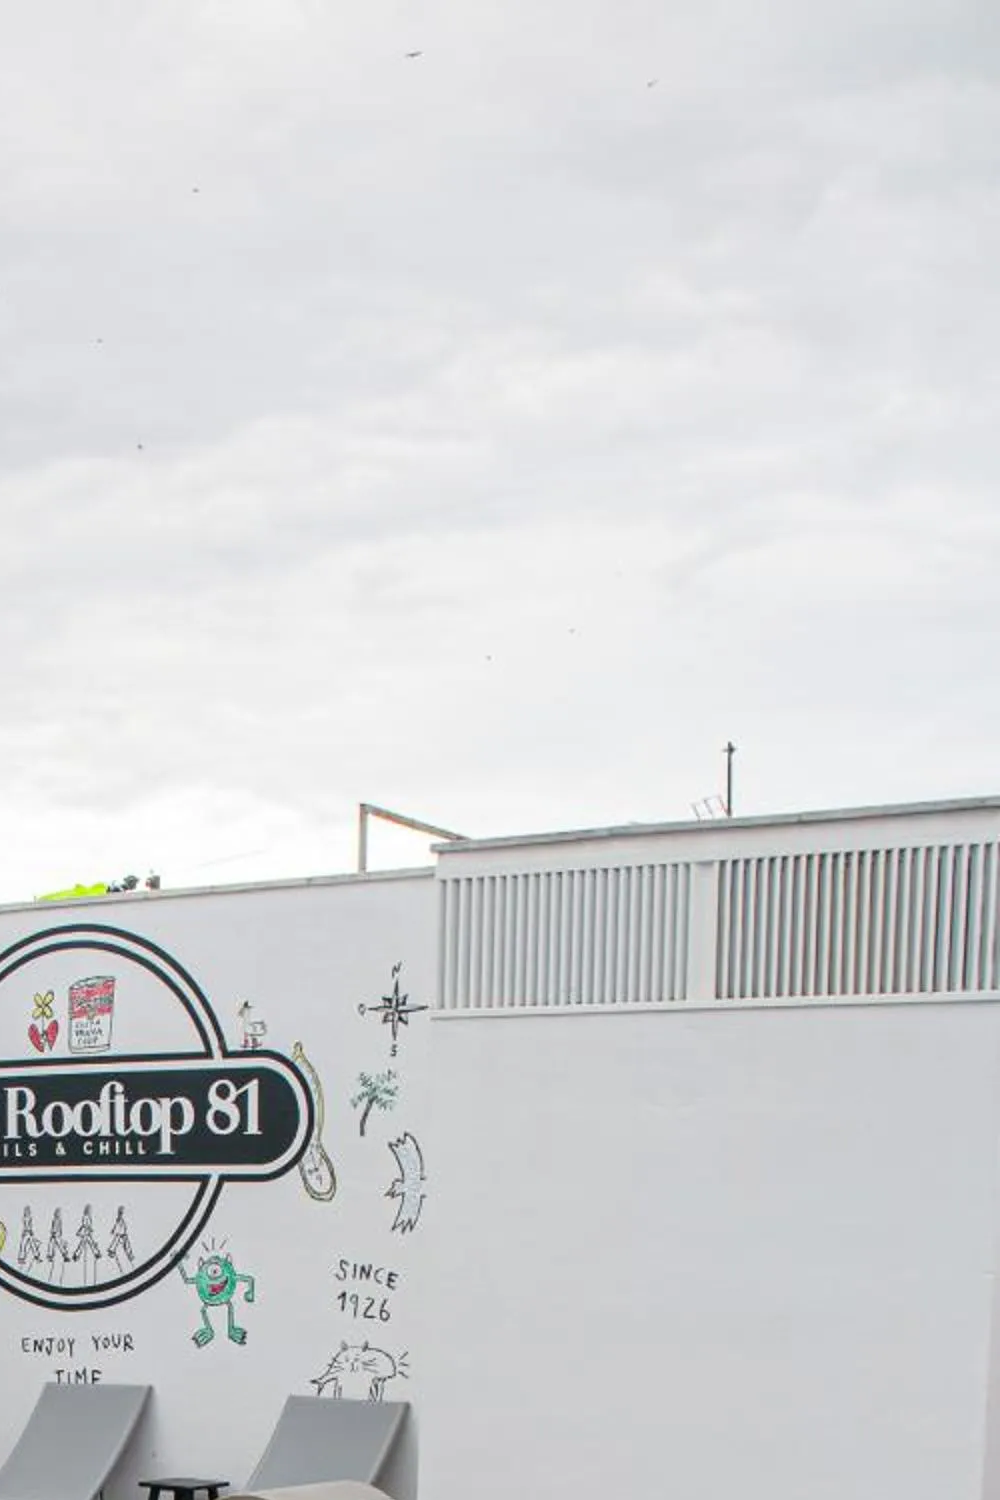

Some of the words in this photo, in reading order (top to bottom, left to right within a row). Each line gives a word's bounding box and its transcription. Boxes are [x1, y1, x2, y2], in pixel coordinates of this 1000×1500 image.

[3, 1081, 194, 1155] Rooftop
[206, 1078, 263, 1136] 81
[55, 1142, 67, 1155] &
[83, 1140, 147, 1156] CHILL
[335, 1259, 399, 1291] SINCE
[337, 1291, 391, 1322] 1926
[21, 1337, 76, 1358] ENJOY
[91, 1333, 135, 1352] YOUR
